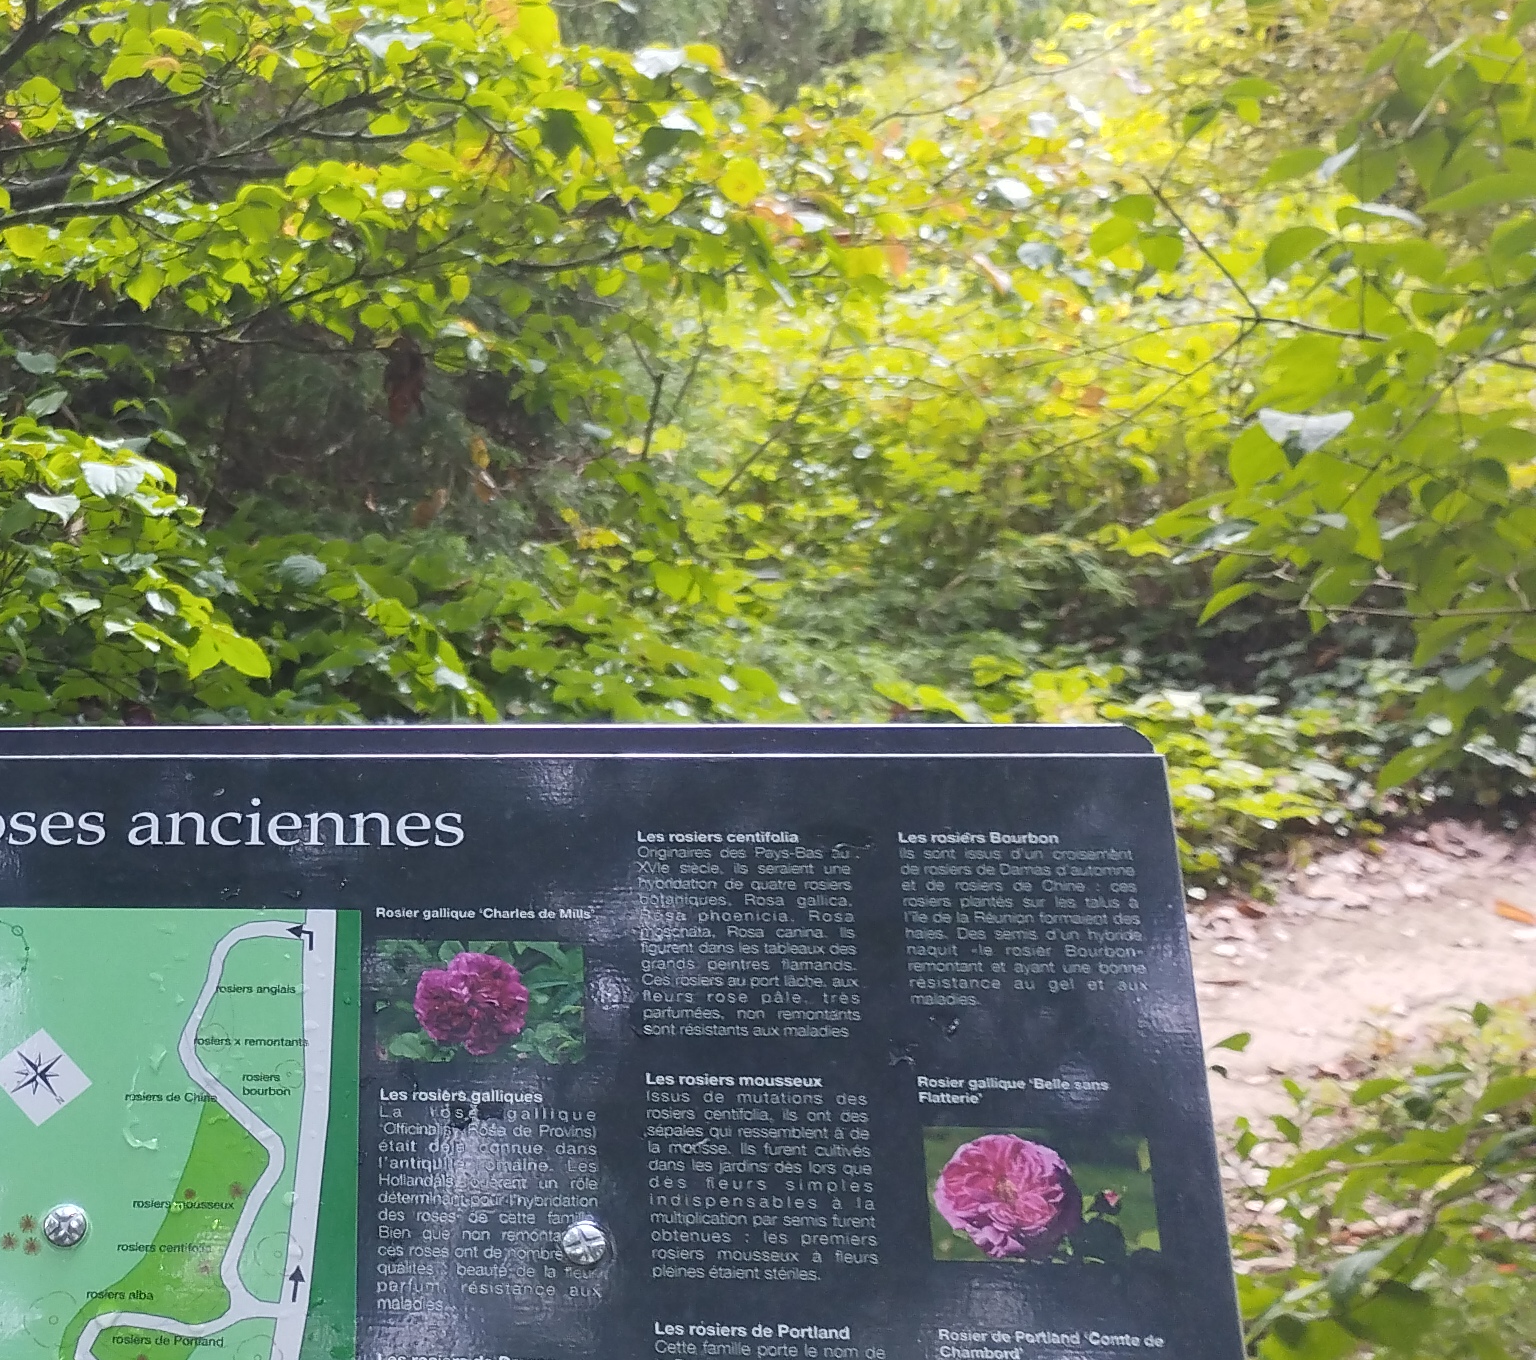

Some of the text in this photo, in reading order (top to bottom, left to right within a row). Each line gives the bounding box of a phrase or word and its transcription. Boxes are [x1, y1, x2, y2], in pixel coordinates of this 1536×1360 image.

[128, 798, 464, 847] anciennes
[637, 831, 799, 843] Les rosiers centifolia
[898, 832, 1059, 844] Les rosiers Bourbon
[376, 907, 418, 918] Rosier
[423, 908, 475, 921] gallique
[539, 909, 556, 919] de
[216, 984, 295, 995] rosiers anglais
[194, 1037, 230, 1046] rosiers
[244, 1038, 309, 1047] remontants
[242, 1073, 280, 1082] rosiers
[646, 1073, 823, 1087] Les rosiers mousseux
[918, 1076, 964, 1089] Rosier
[968, 1076, 1026, 1091] gallique
[1075, 1081, 1109, 1091] sans
[243, 1087, 290, 1096] bourbon
[379, 1088, 543, 1105] Les rosiers galliques
[125, 1093, 217, 1103] rosiers de Chine
[133, 1200, 170, 1208] rosiers
[117, 1243, 156, 1252] rosiers
[652, 1264, 820, 1281] pleines étaient stériles.
[87, 1290, 154, 1300] rosiers alba
[655, 1322, 850, 1340] Les rosiers de Portland
[112, 1335, 151, 1345] rosiers
[155, 1336, 169, 1345] de
[938, 1329, 987, 1342] Rosier
[991, 1332, 1011, 1343] de
[1015, 1331, 1080, 1345] Portland
[1144, 1335, 1164, 1348] de
